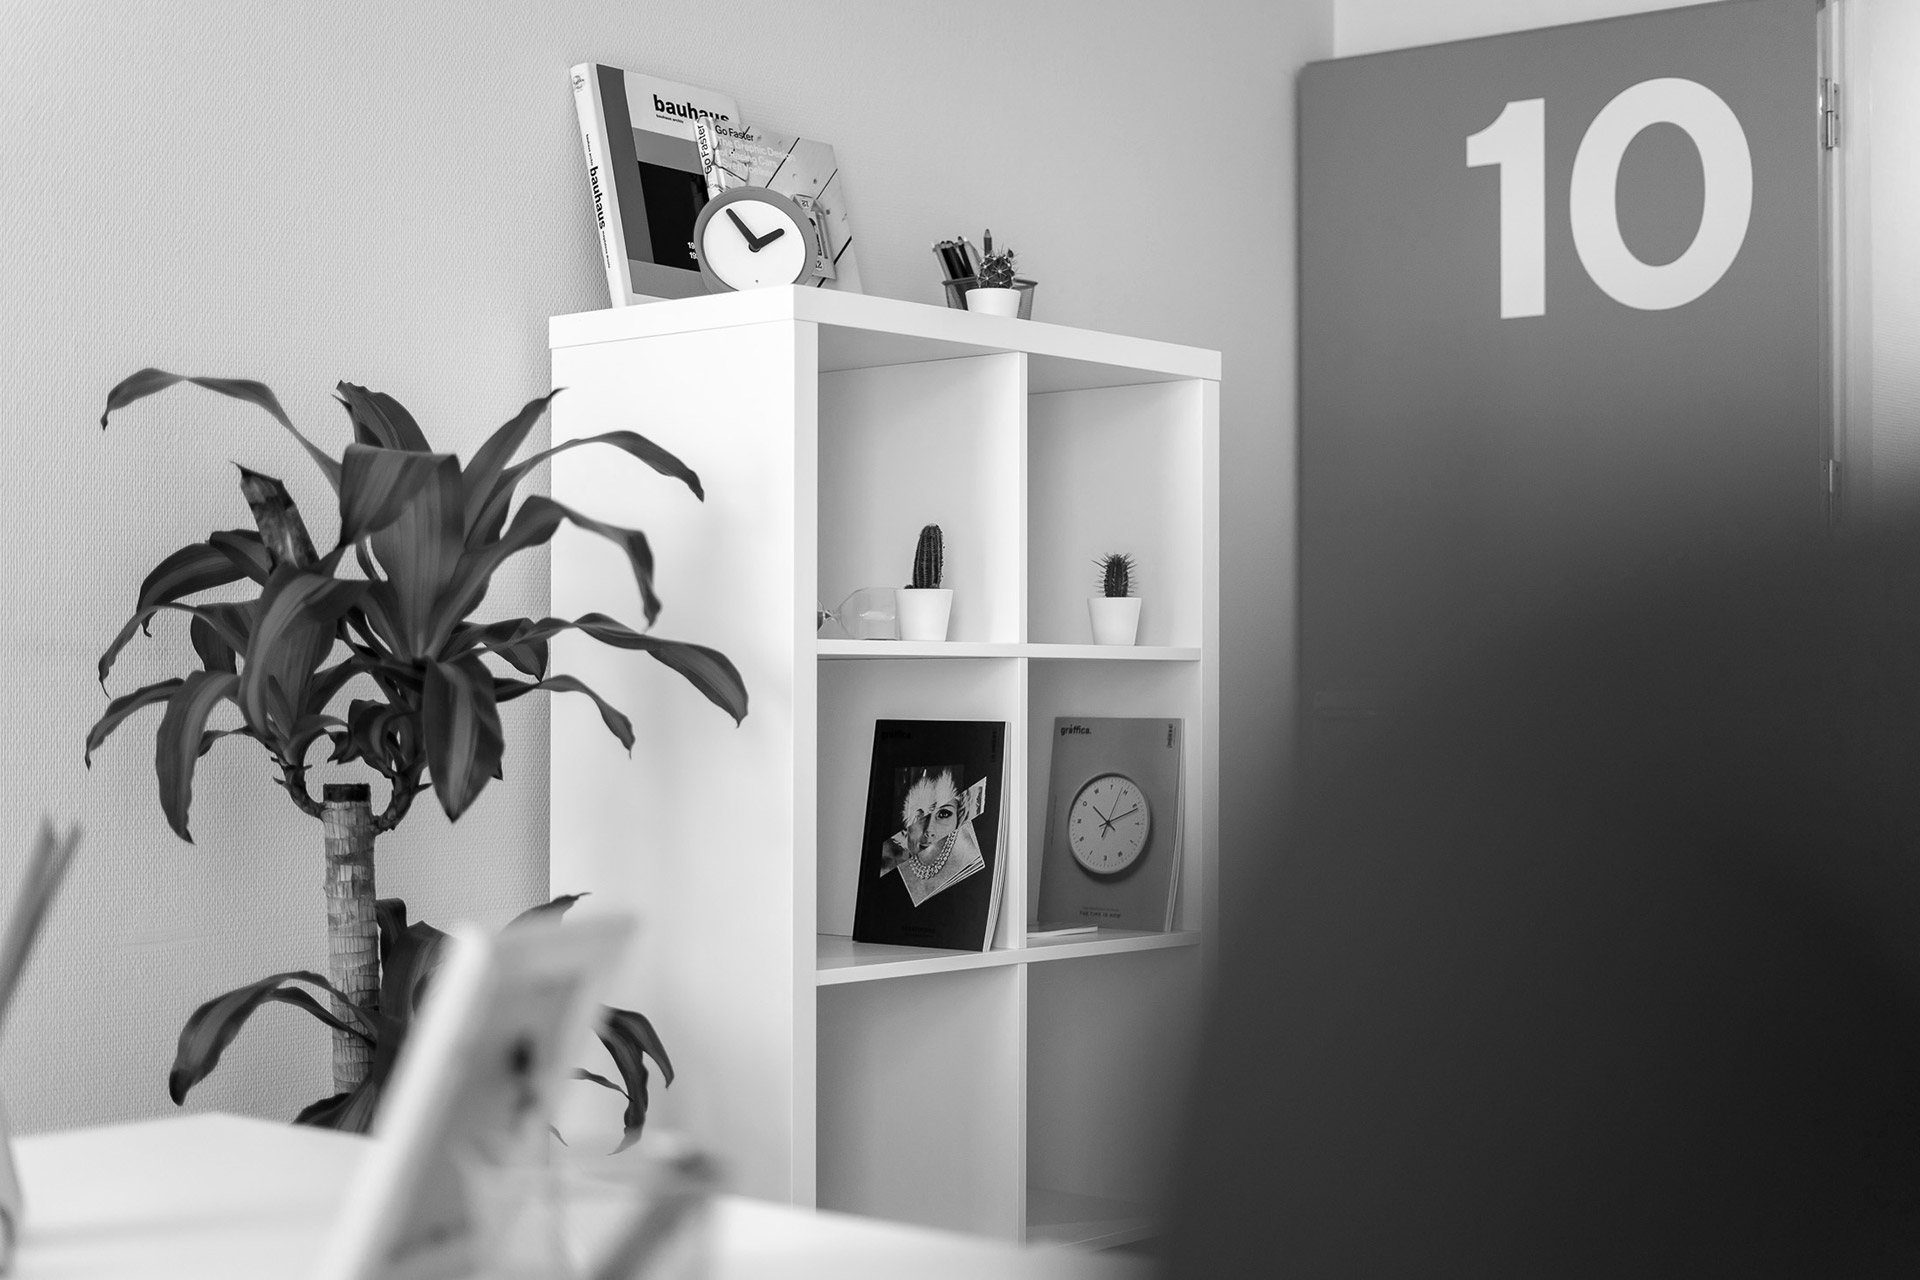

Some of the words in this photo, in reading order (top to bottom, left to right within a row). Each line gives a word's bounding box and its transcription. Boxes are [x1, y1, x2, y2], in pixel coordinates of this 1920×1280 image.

[697, 125, 709, 158] Faster
[715, 125, 728, 136] Go
[728, 127, 754, 142] Faster
[702, 158, 713, 175] Go
[590, 166, 606, 230] bauhaus
[1466, 77, 1753, 319] 10
